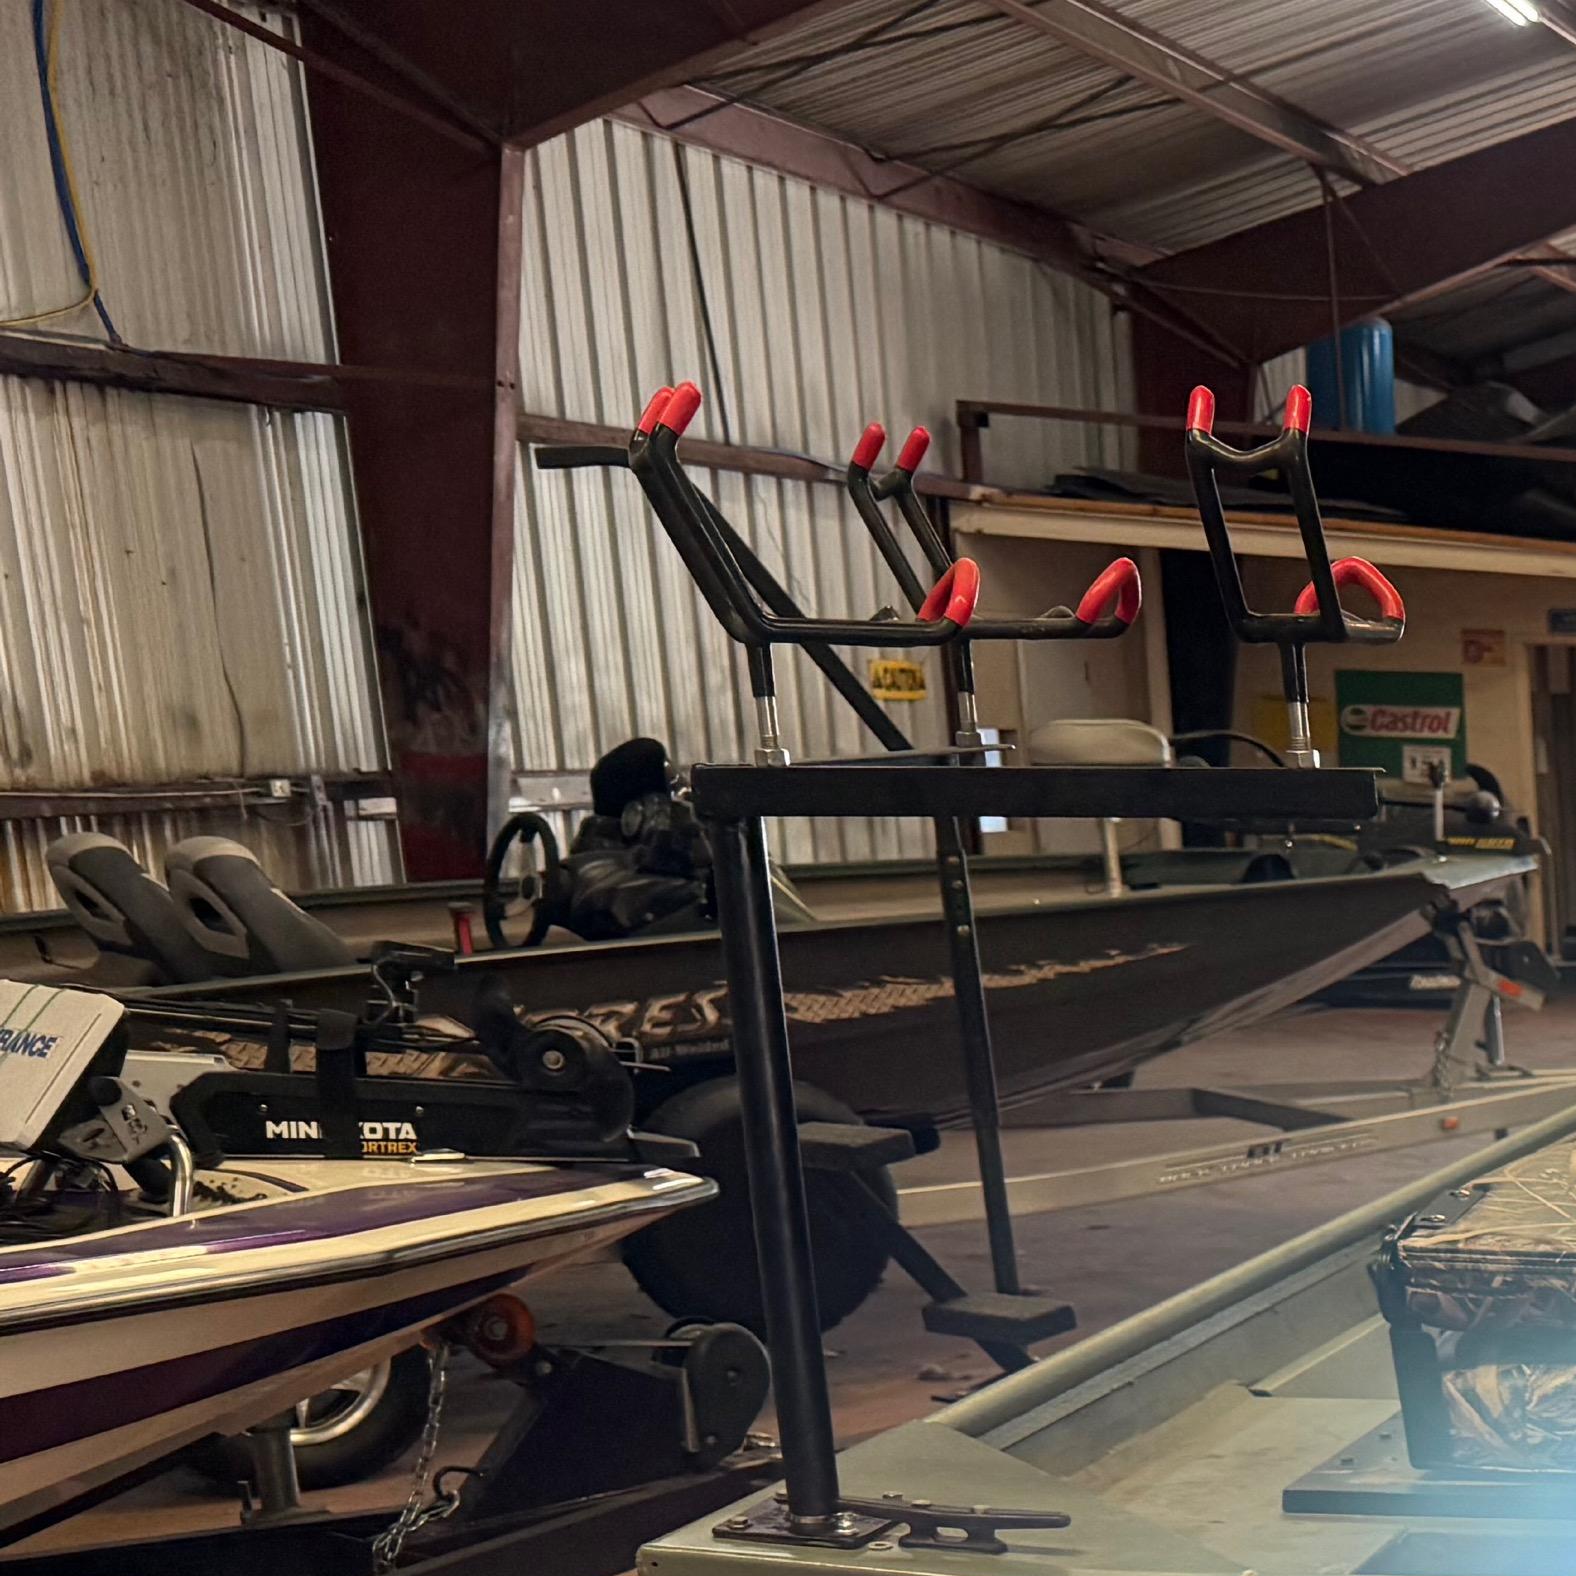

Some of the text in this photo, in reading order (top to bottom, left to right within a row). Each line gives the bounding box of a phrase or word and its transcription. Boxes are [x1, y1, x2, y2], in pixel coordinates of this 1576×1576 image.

[1370, 708, 1451, 734] Castrol
[265, 1120, 418, 1140] MIN OTA
